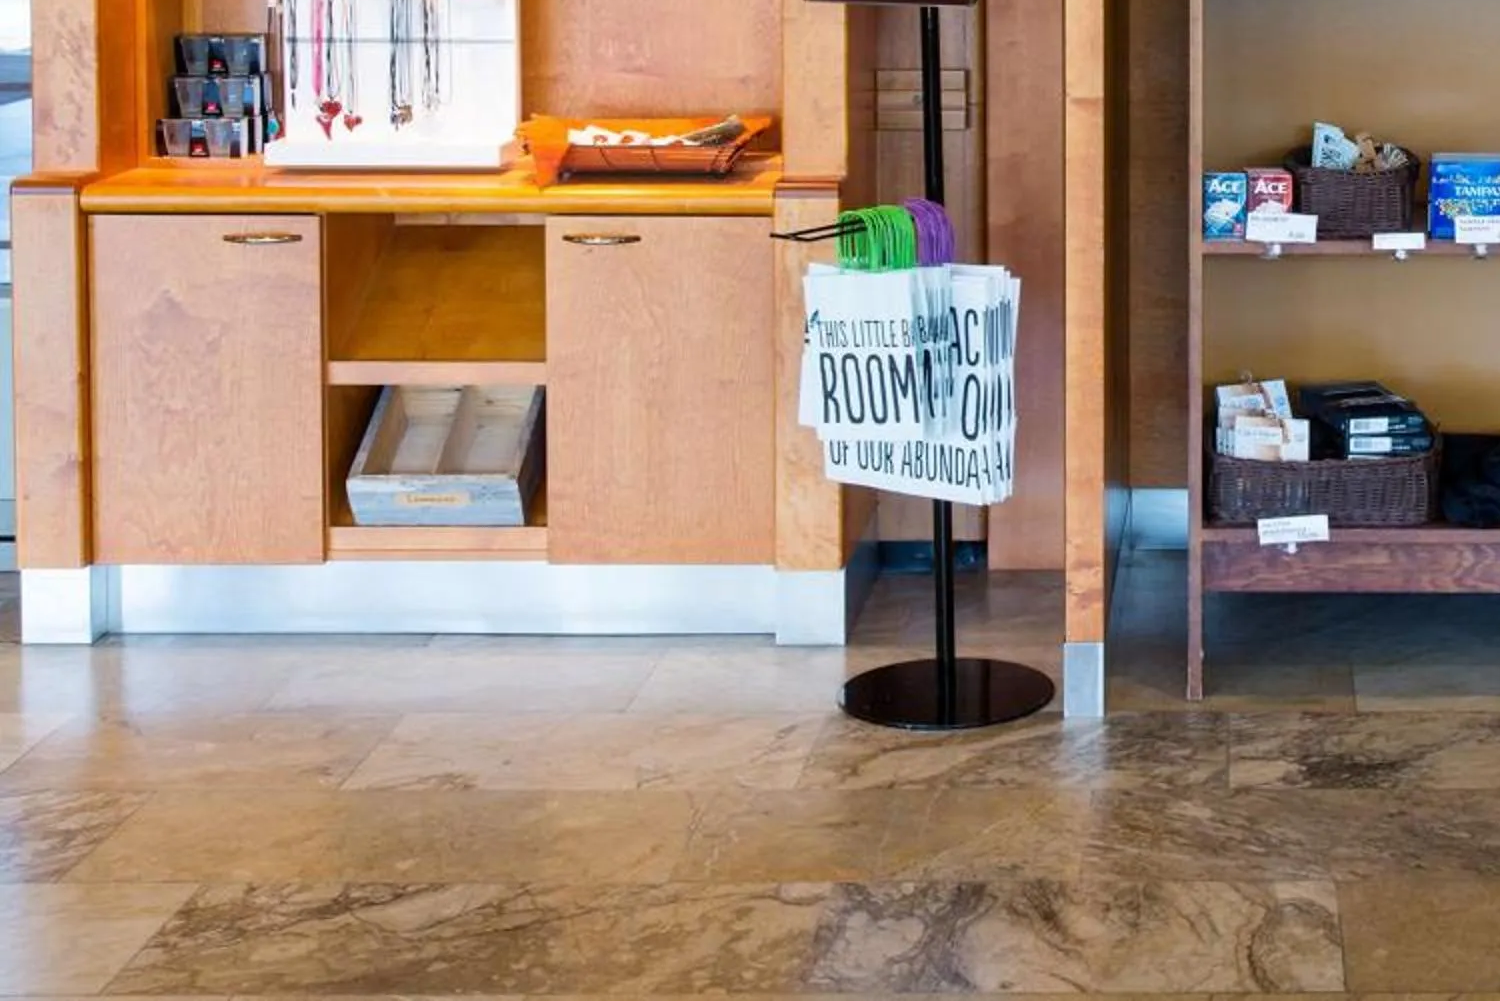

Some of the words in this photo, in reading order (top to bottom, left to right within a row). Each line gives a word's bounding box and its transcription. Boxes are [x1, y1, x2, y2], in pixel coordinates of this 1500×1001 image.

[1208, 180, 1242, 194] ACE
[1254, 178, 1288, 195] ACE
[819, 319, 848, 348] THIS
[851, 319, 899, 348] LITTLE
[819, 352, 920, 425] ROOM
[901, 441, 982, 491] ABUNDA
